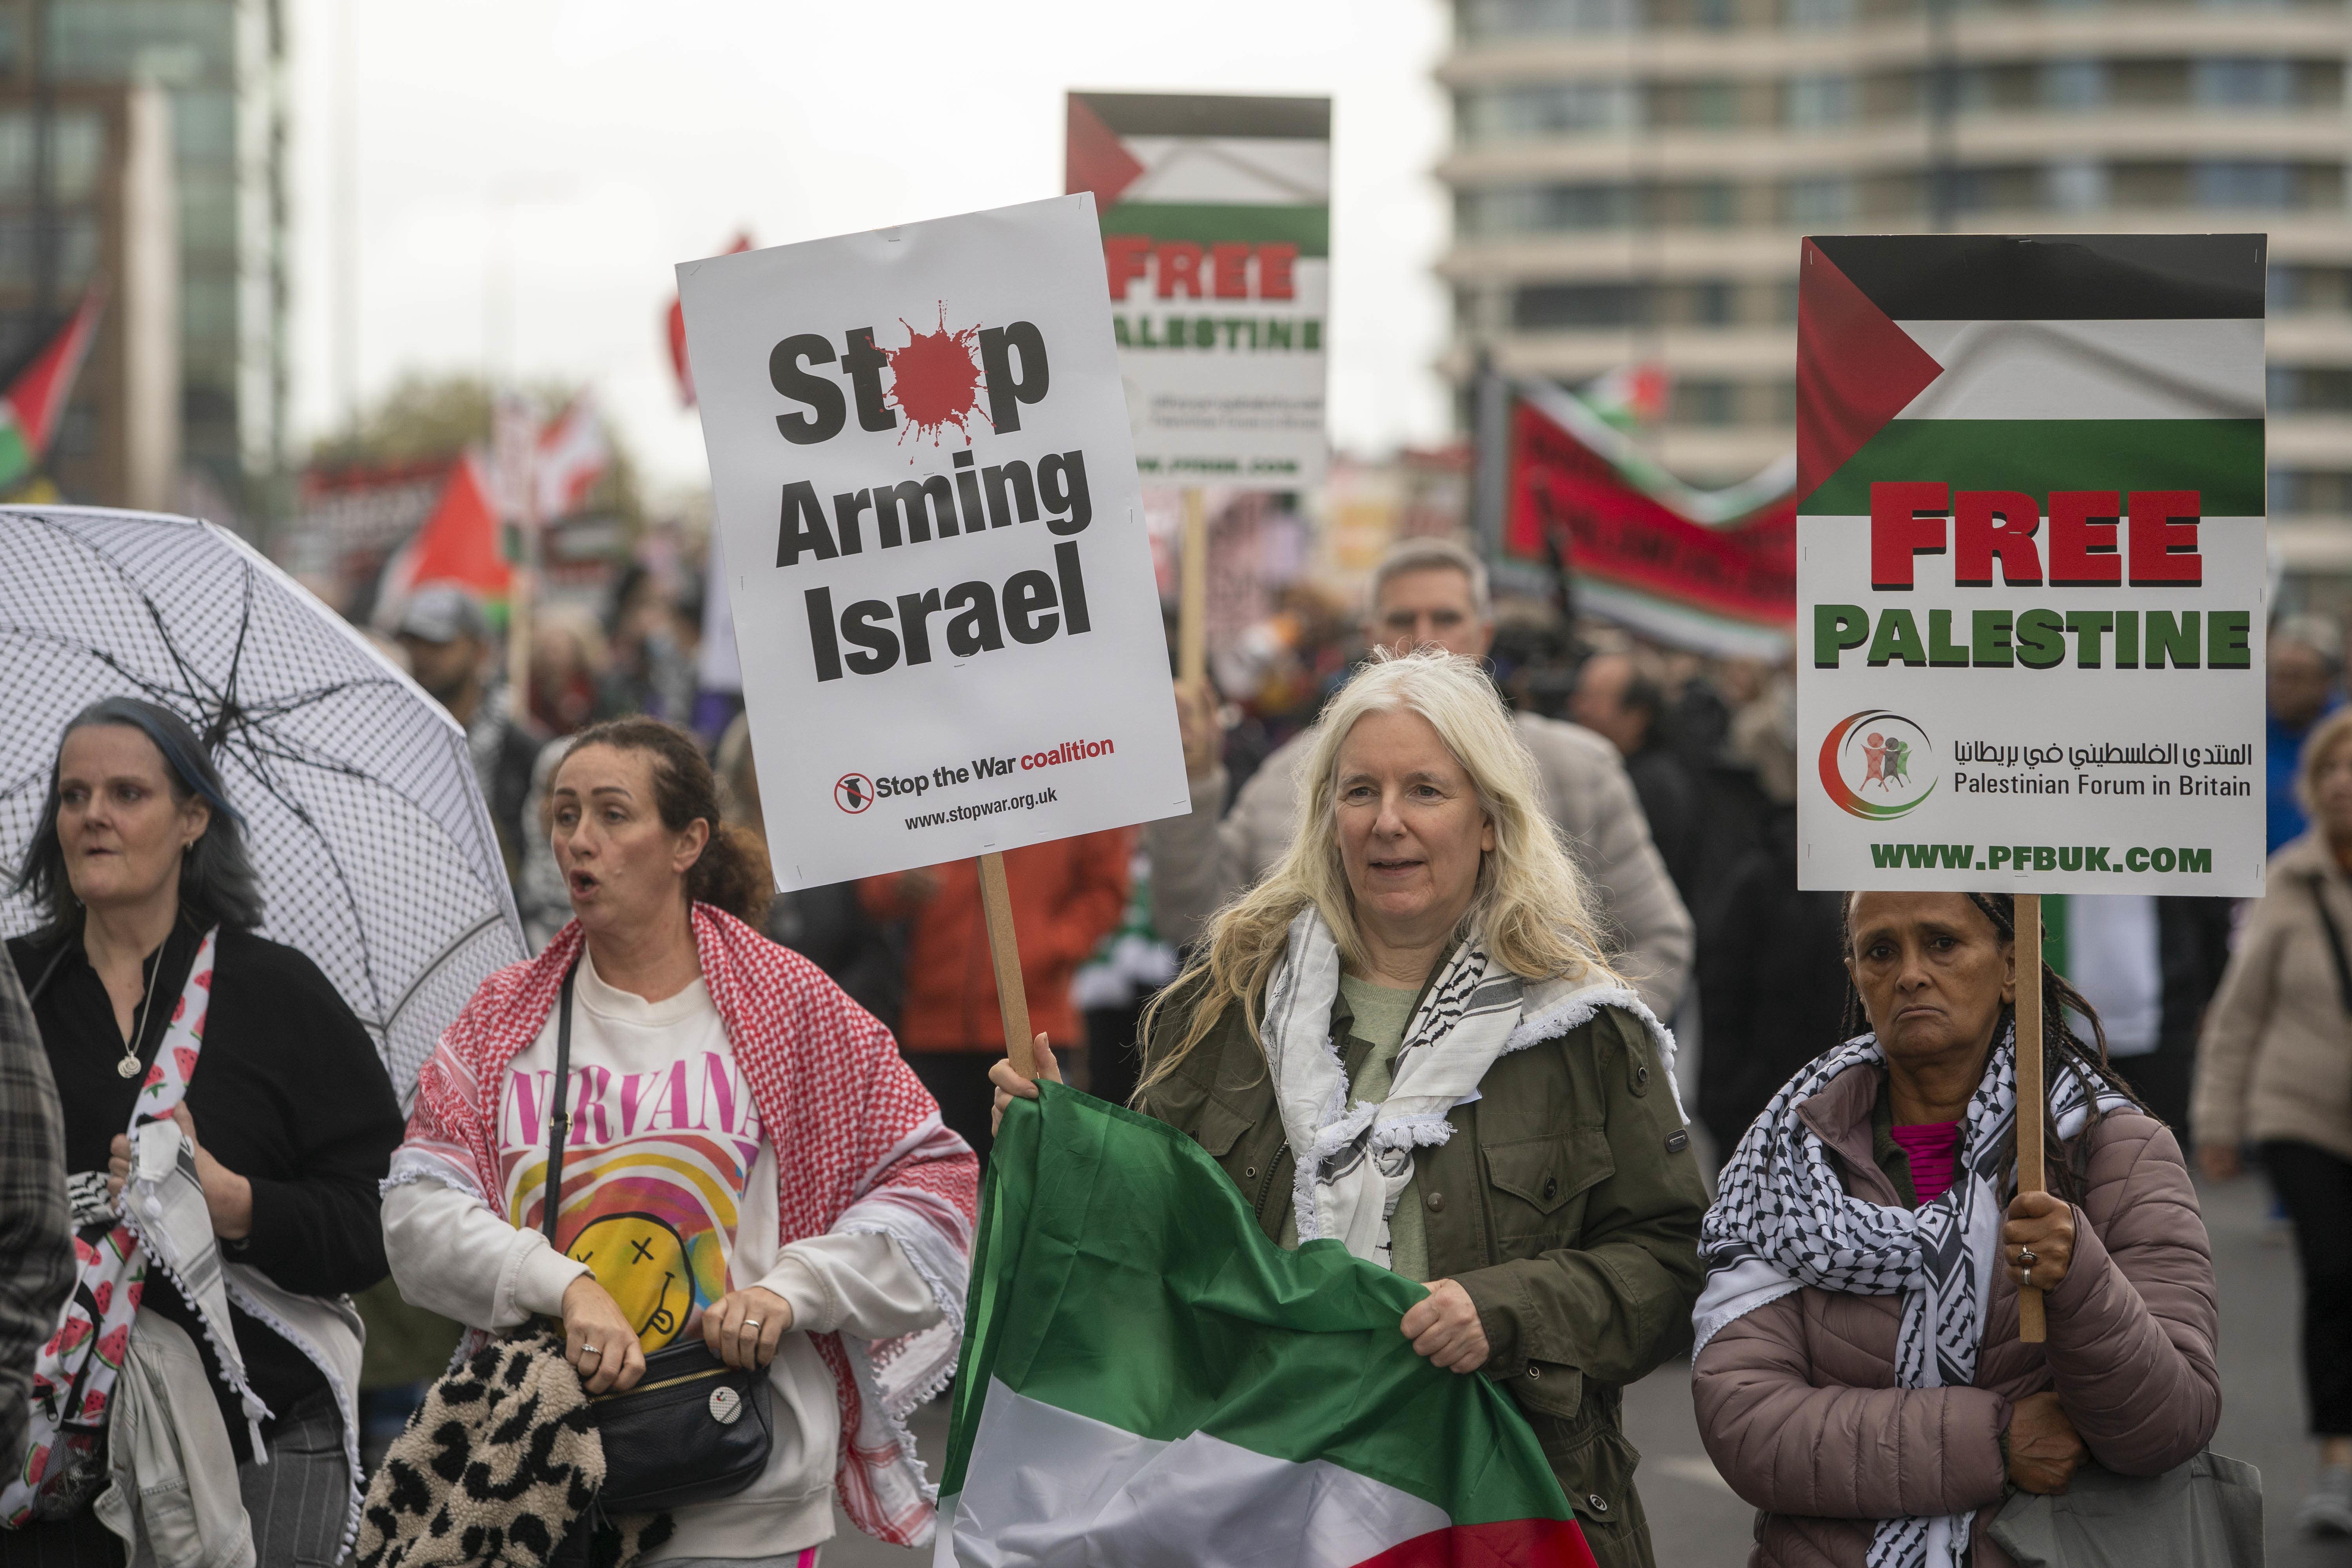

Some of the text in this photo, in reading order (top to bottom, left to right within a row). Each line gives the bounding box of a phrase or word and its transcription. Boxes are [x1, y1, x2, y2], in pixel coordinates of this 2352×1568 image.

[1105, 234, 1297, 300] FREE
[1112, 316, 1321, 350] ALESTINE
[769, 320, 1050, 446] Stop
[775, 449, 1093, 568] Arming
[1870, 481, 2202, 591] FREE
[804, 540, 1091, 683] Israel
[1814, 604, 2251, 670] PALESTINE
[875, 739, 1114, 798] Stop the War coalition
[1955, 740, 2252, 770] المنتدى الفلسطيني في بريطانيا
[1955, 772, 2250, 796] Palestinian Forum in Britain
[904, 787, 1058, 830] www.stopwar.org.uk
[1870, 844, 2212, 873] WWW.PFBUK.COM
